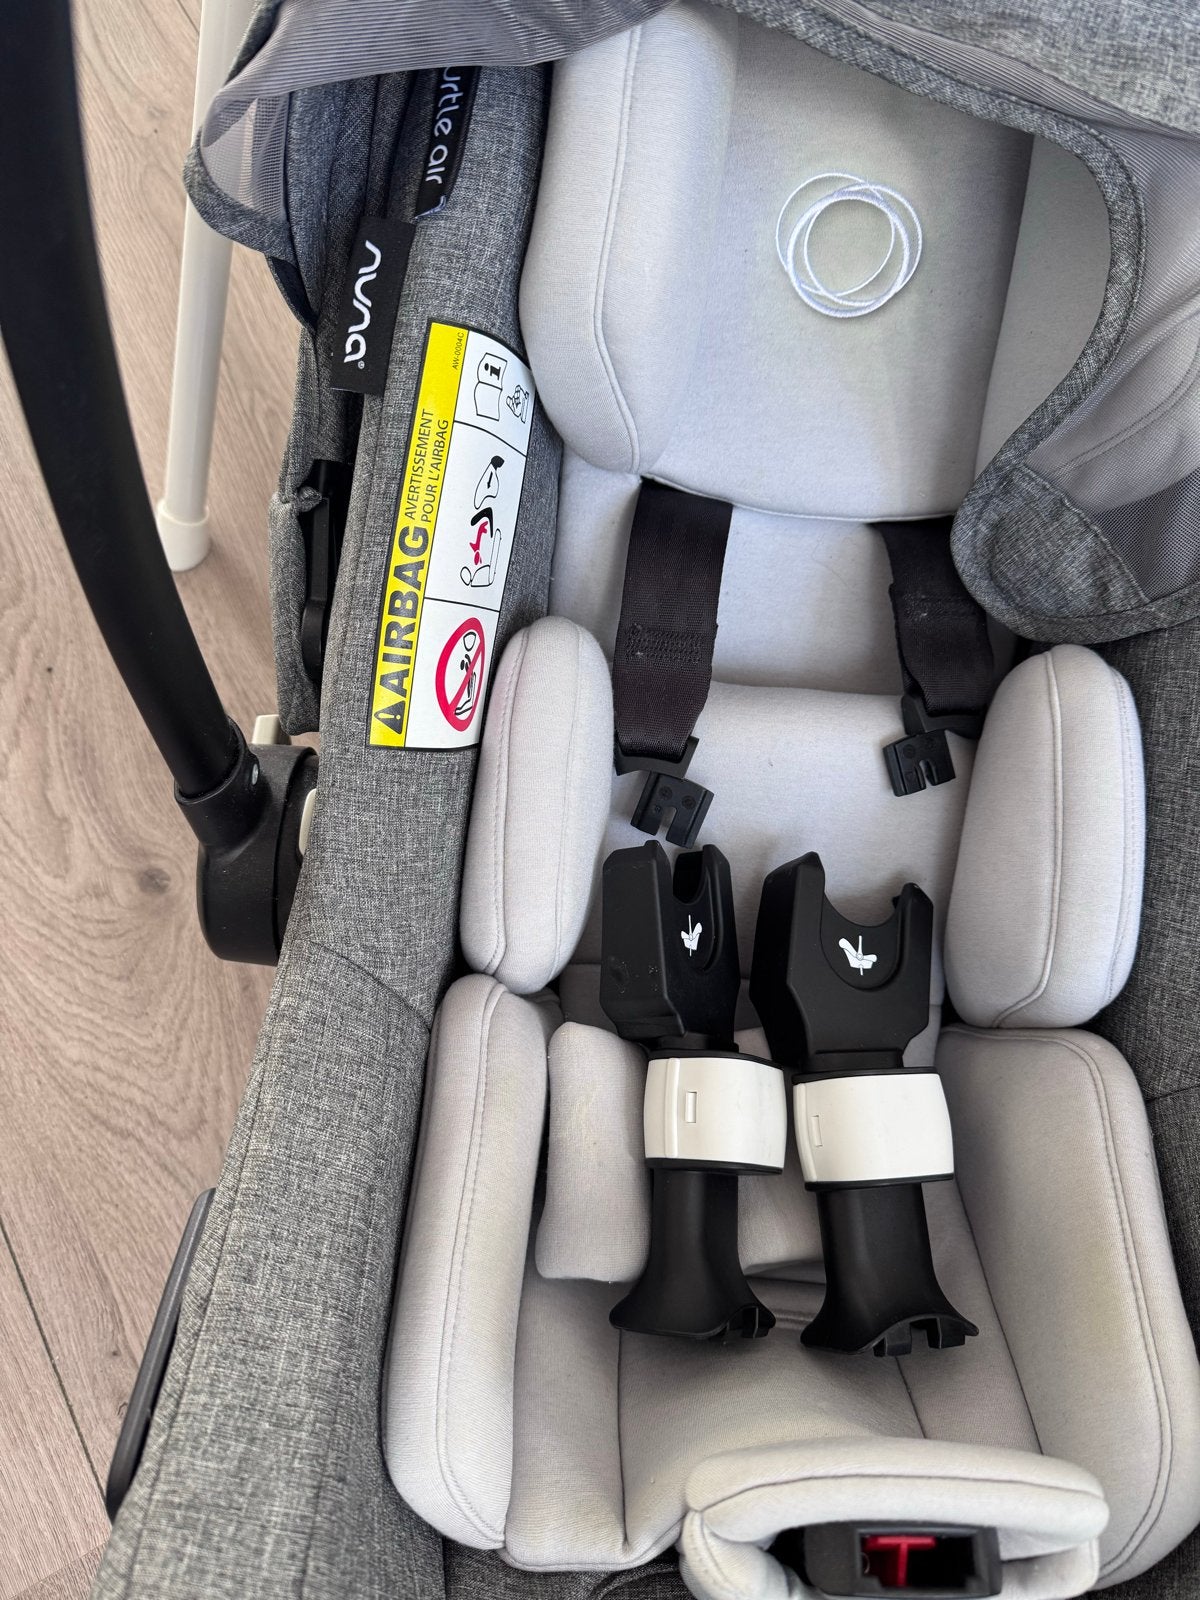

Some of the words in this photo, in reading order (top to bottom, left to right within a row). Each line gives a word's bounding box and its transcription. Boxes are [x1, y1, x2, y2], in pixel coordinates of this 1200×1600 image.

[425, 144, 448, 184] air
[452, 332, 465, 371] AW-0004C
[404, 408, 434, 520] AVERTISSEMENT
[421, 485, 438, 523] POUR
[432, 419, 449, 480] L'AIRBAG
[379, 526, 429, 698] AIRBAG
